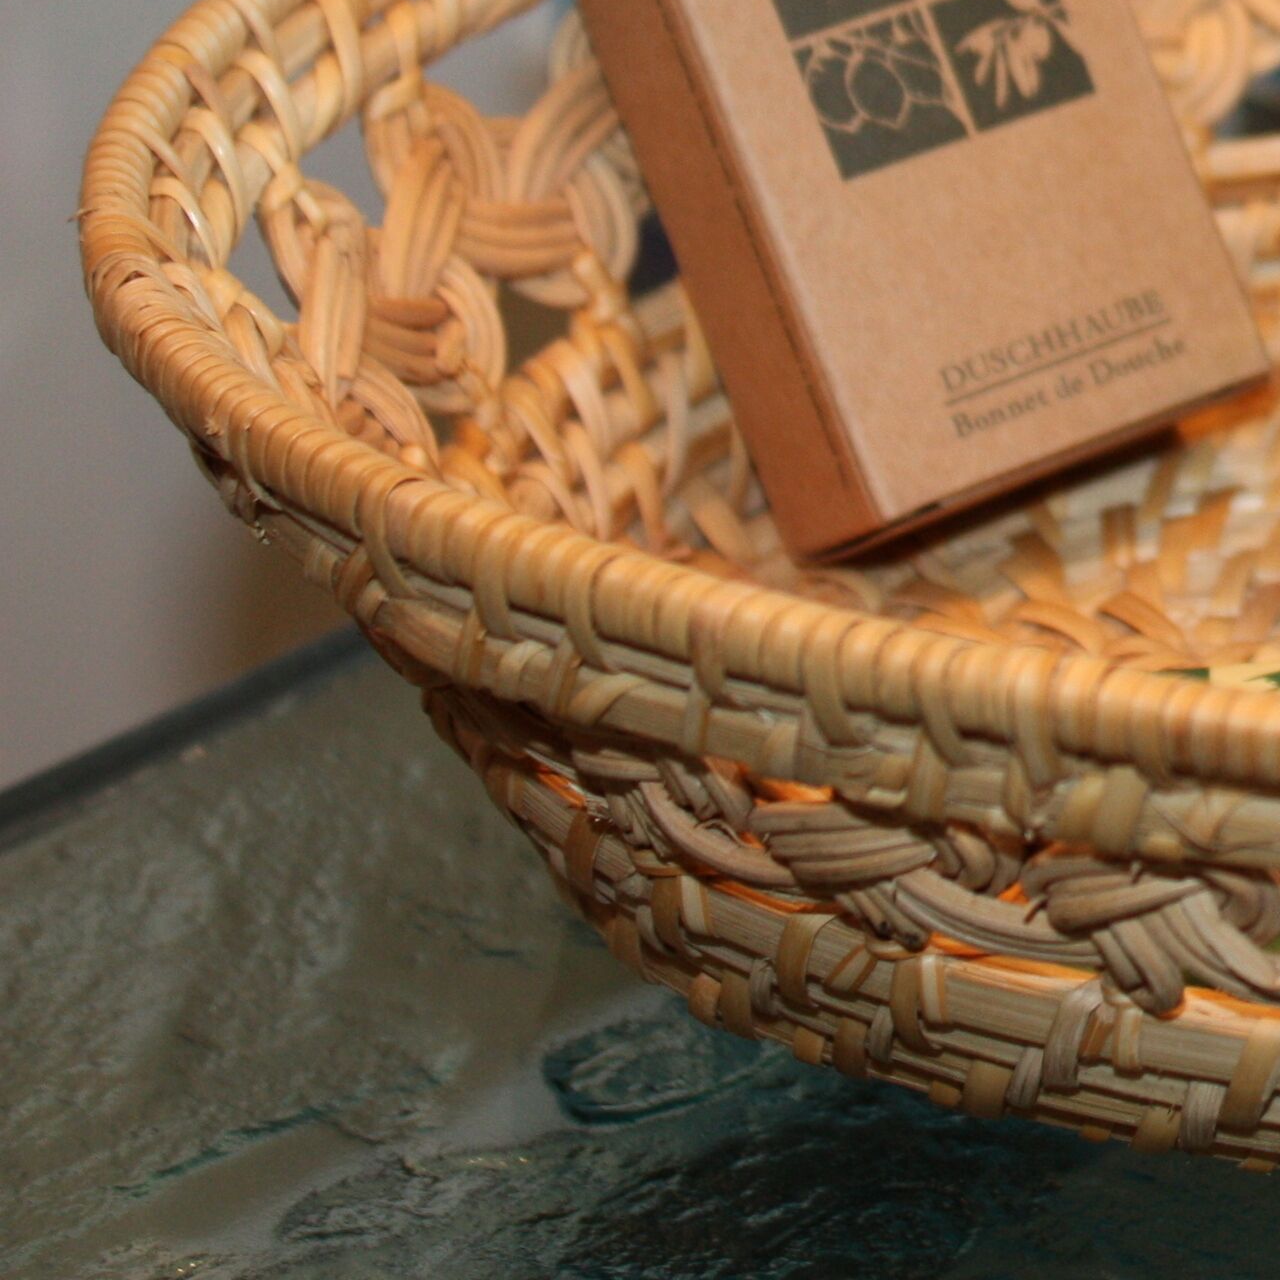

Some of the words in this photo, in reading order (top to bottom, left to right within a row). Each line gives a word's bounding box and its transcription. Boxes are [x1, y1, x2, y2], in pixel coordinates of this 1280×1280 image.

[941, 288, 1165, 393] DUSCHHAUBE
[950, 390, 1049, 439] Bonnet
[1056, 372, 1084, 400] de
[1091, 335, 1186, 388] Douche
